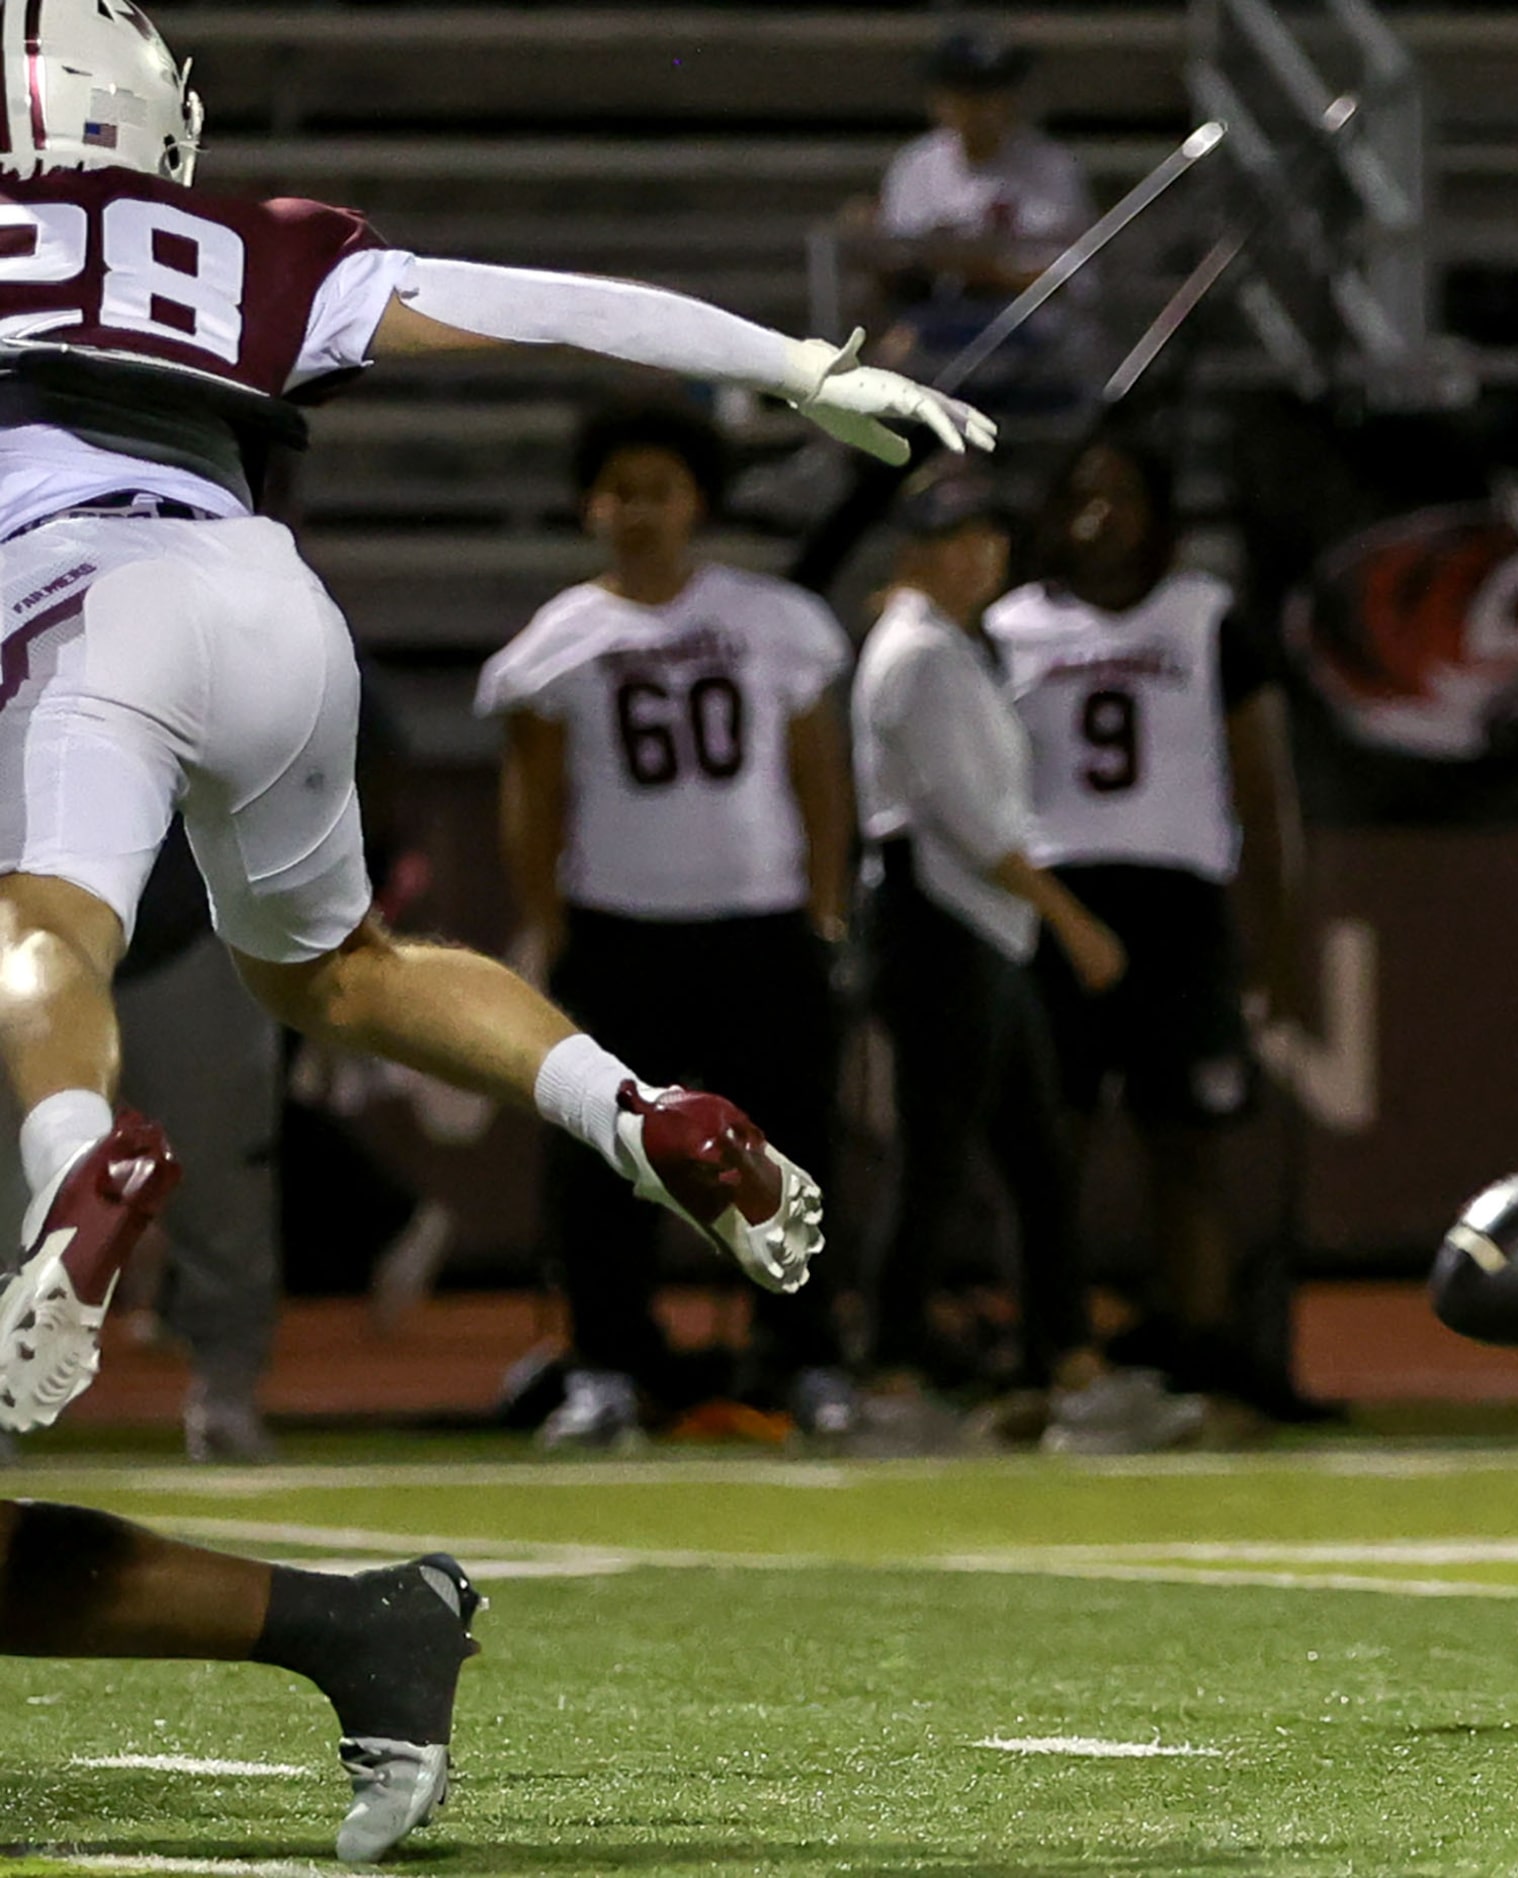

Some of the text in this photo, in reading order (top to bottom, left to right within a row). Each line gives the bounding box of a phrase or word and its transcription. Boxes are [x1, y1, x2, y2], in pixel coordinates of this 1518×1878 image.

[0, 198, 244, 366] 28
[13, 562, 97, 614] FARMERS
[616, 674, 743, 786] 60
[1083, 690, 1137, 793] 9
